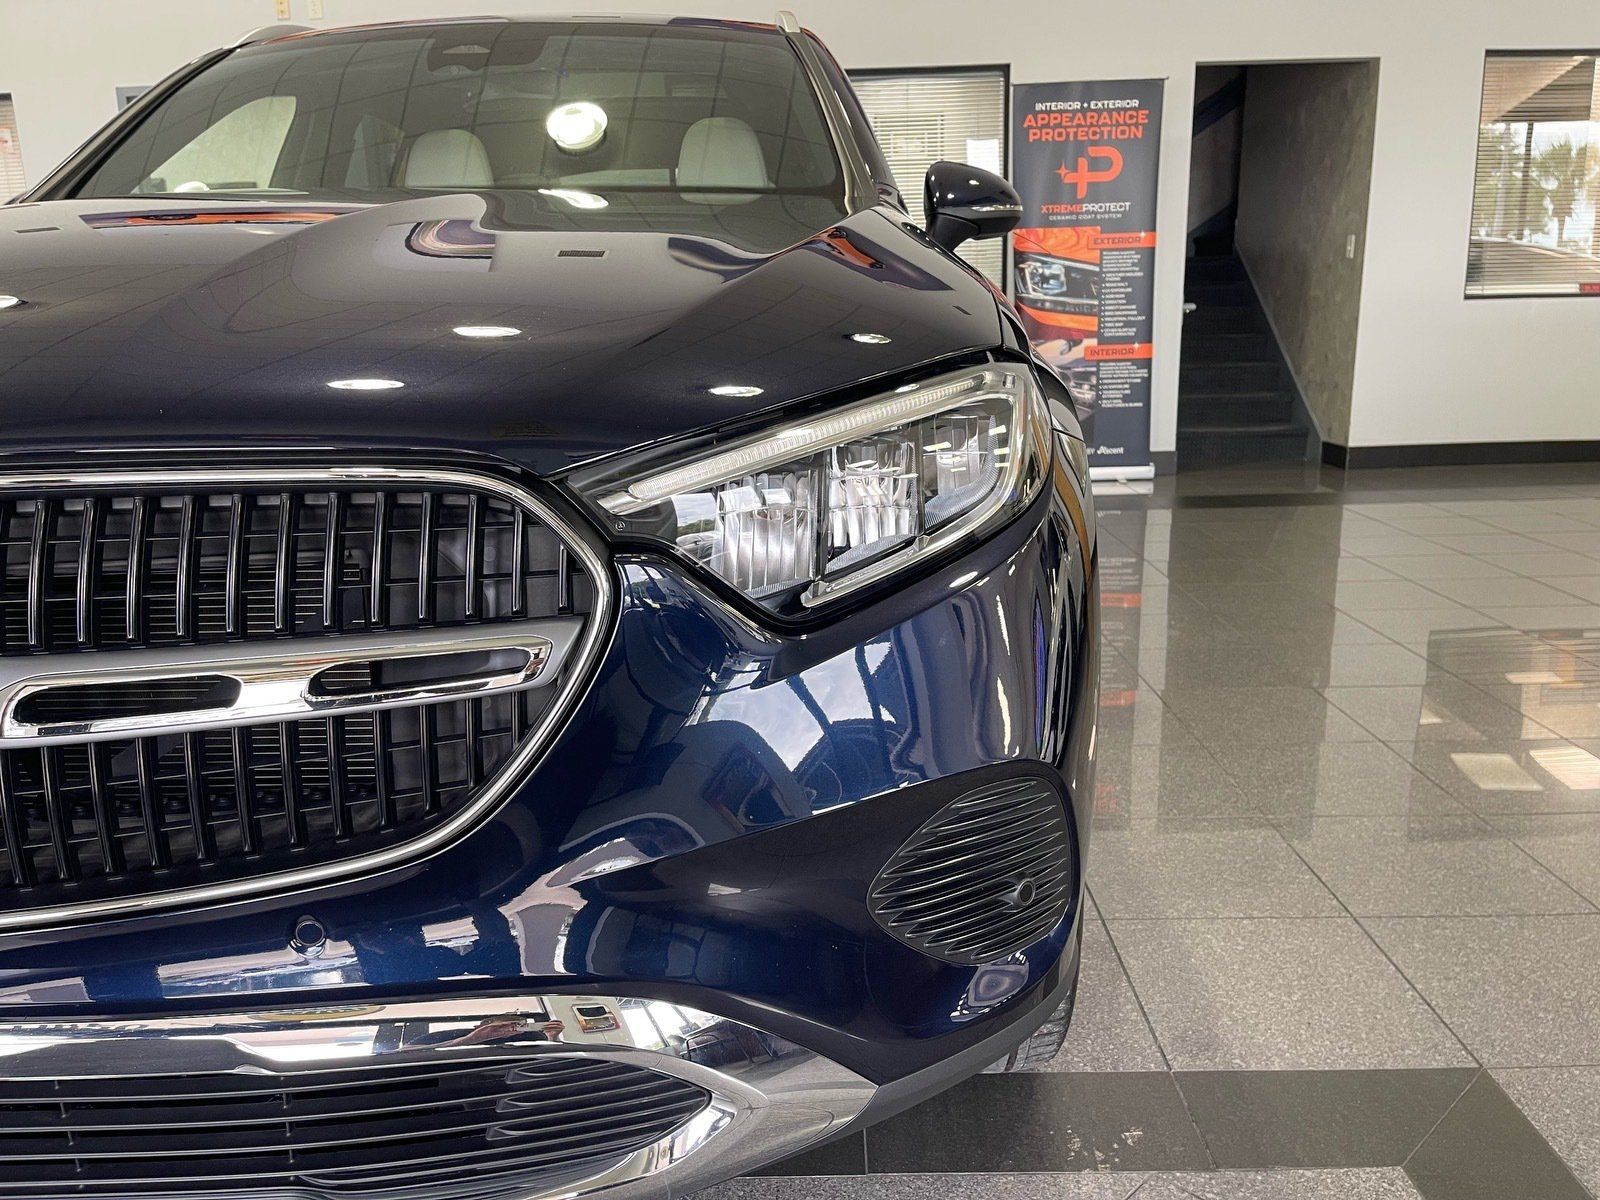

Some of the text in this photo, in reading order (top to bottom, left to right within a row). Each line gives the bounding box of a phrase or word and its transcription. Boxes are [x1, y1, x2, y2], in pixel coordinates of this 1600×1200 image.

[1035, 101, 1081, 111] INTERIOR
[1090, 99, 1140, 110] EXTERIOR
[1023, 110, 1149, 128] APPEARANCE
[1028, 125, 1143, 142] PROTECTION
[1041, 202, 1131, 214] XTREMEPROTECT
[1094, 236, 1141, 245] EXTERIOR
[1090, 348, 1135, 356] INTERIOR
